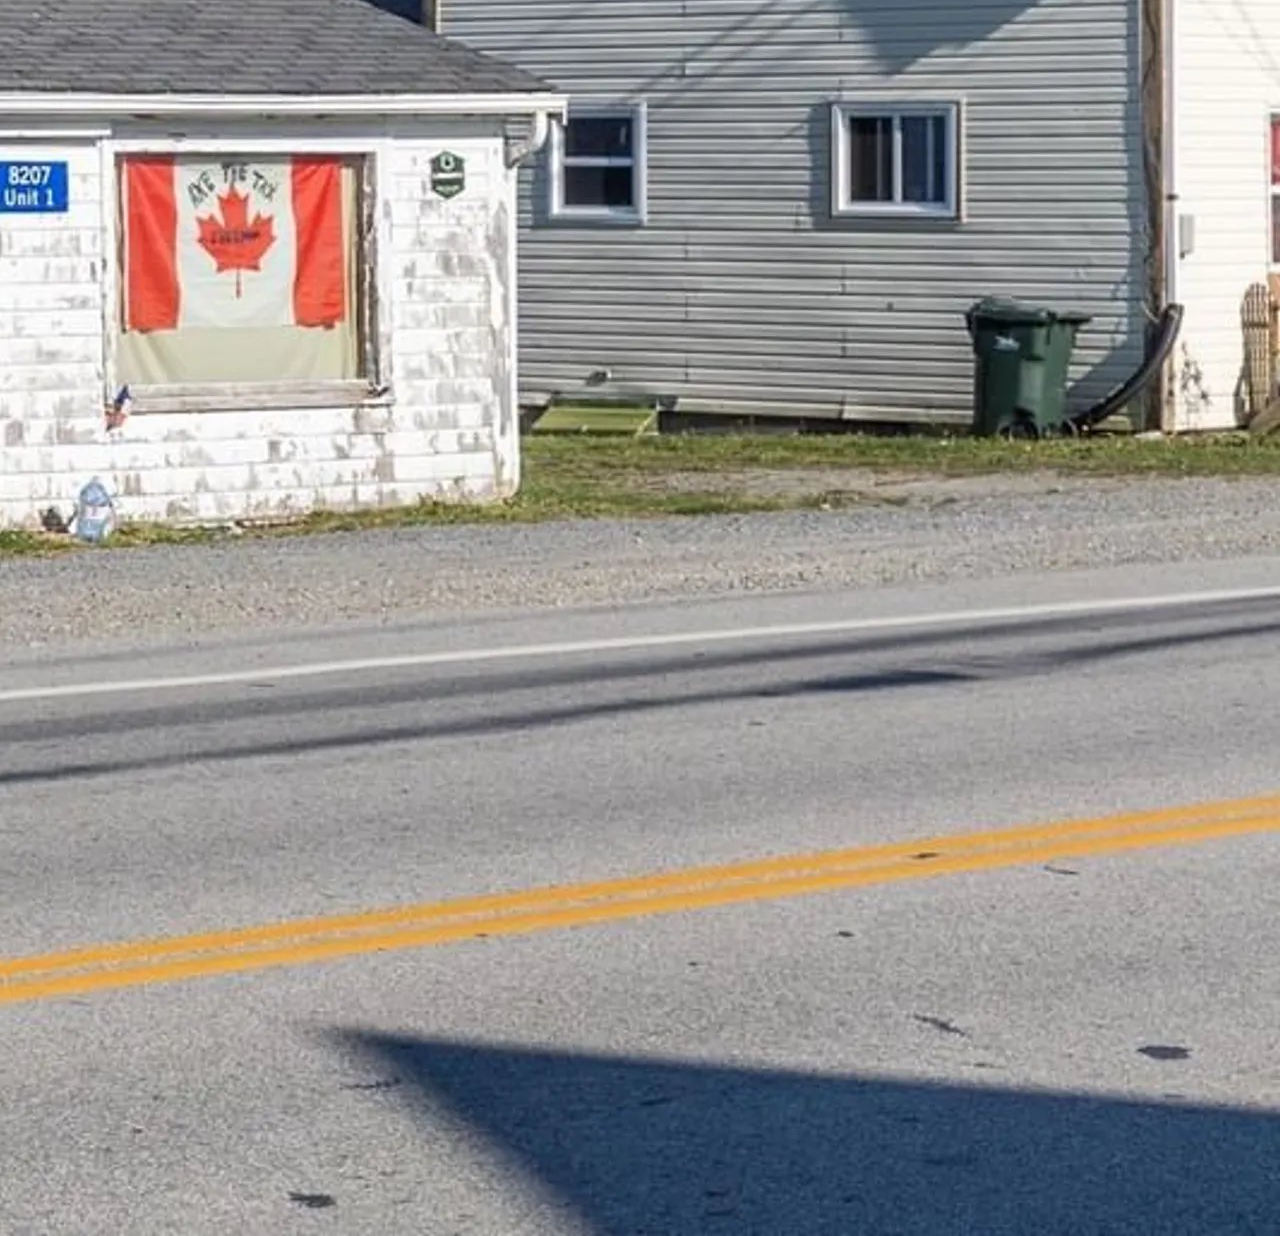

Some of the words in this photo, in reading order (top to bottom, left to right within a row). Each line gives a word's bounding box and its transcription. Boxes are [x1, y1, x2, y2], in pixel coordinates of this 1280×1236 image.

[8, 165, 51, 186] 8207
[4, 187, 38, 207] Unit
[45, 187, 55, 206] 1
